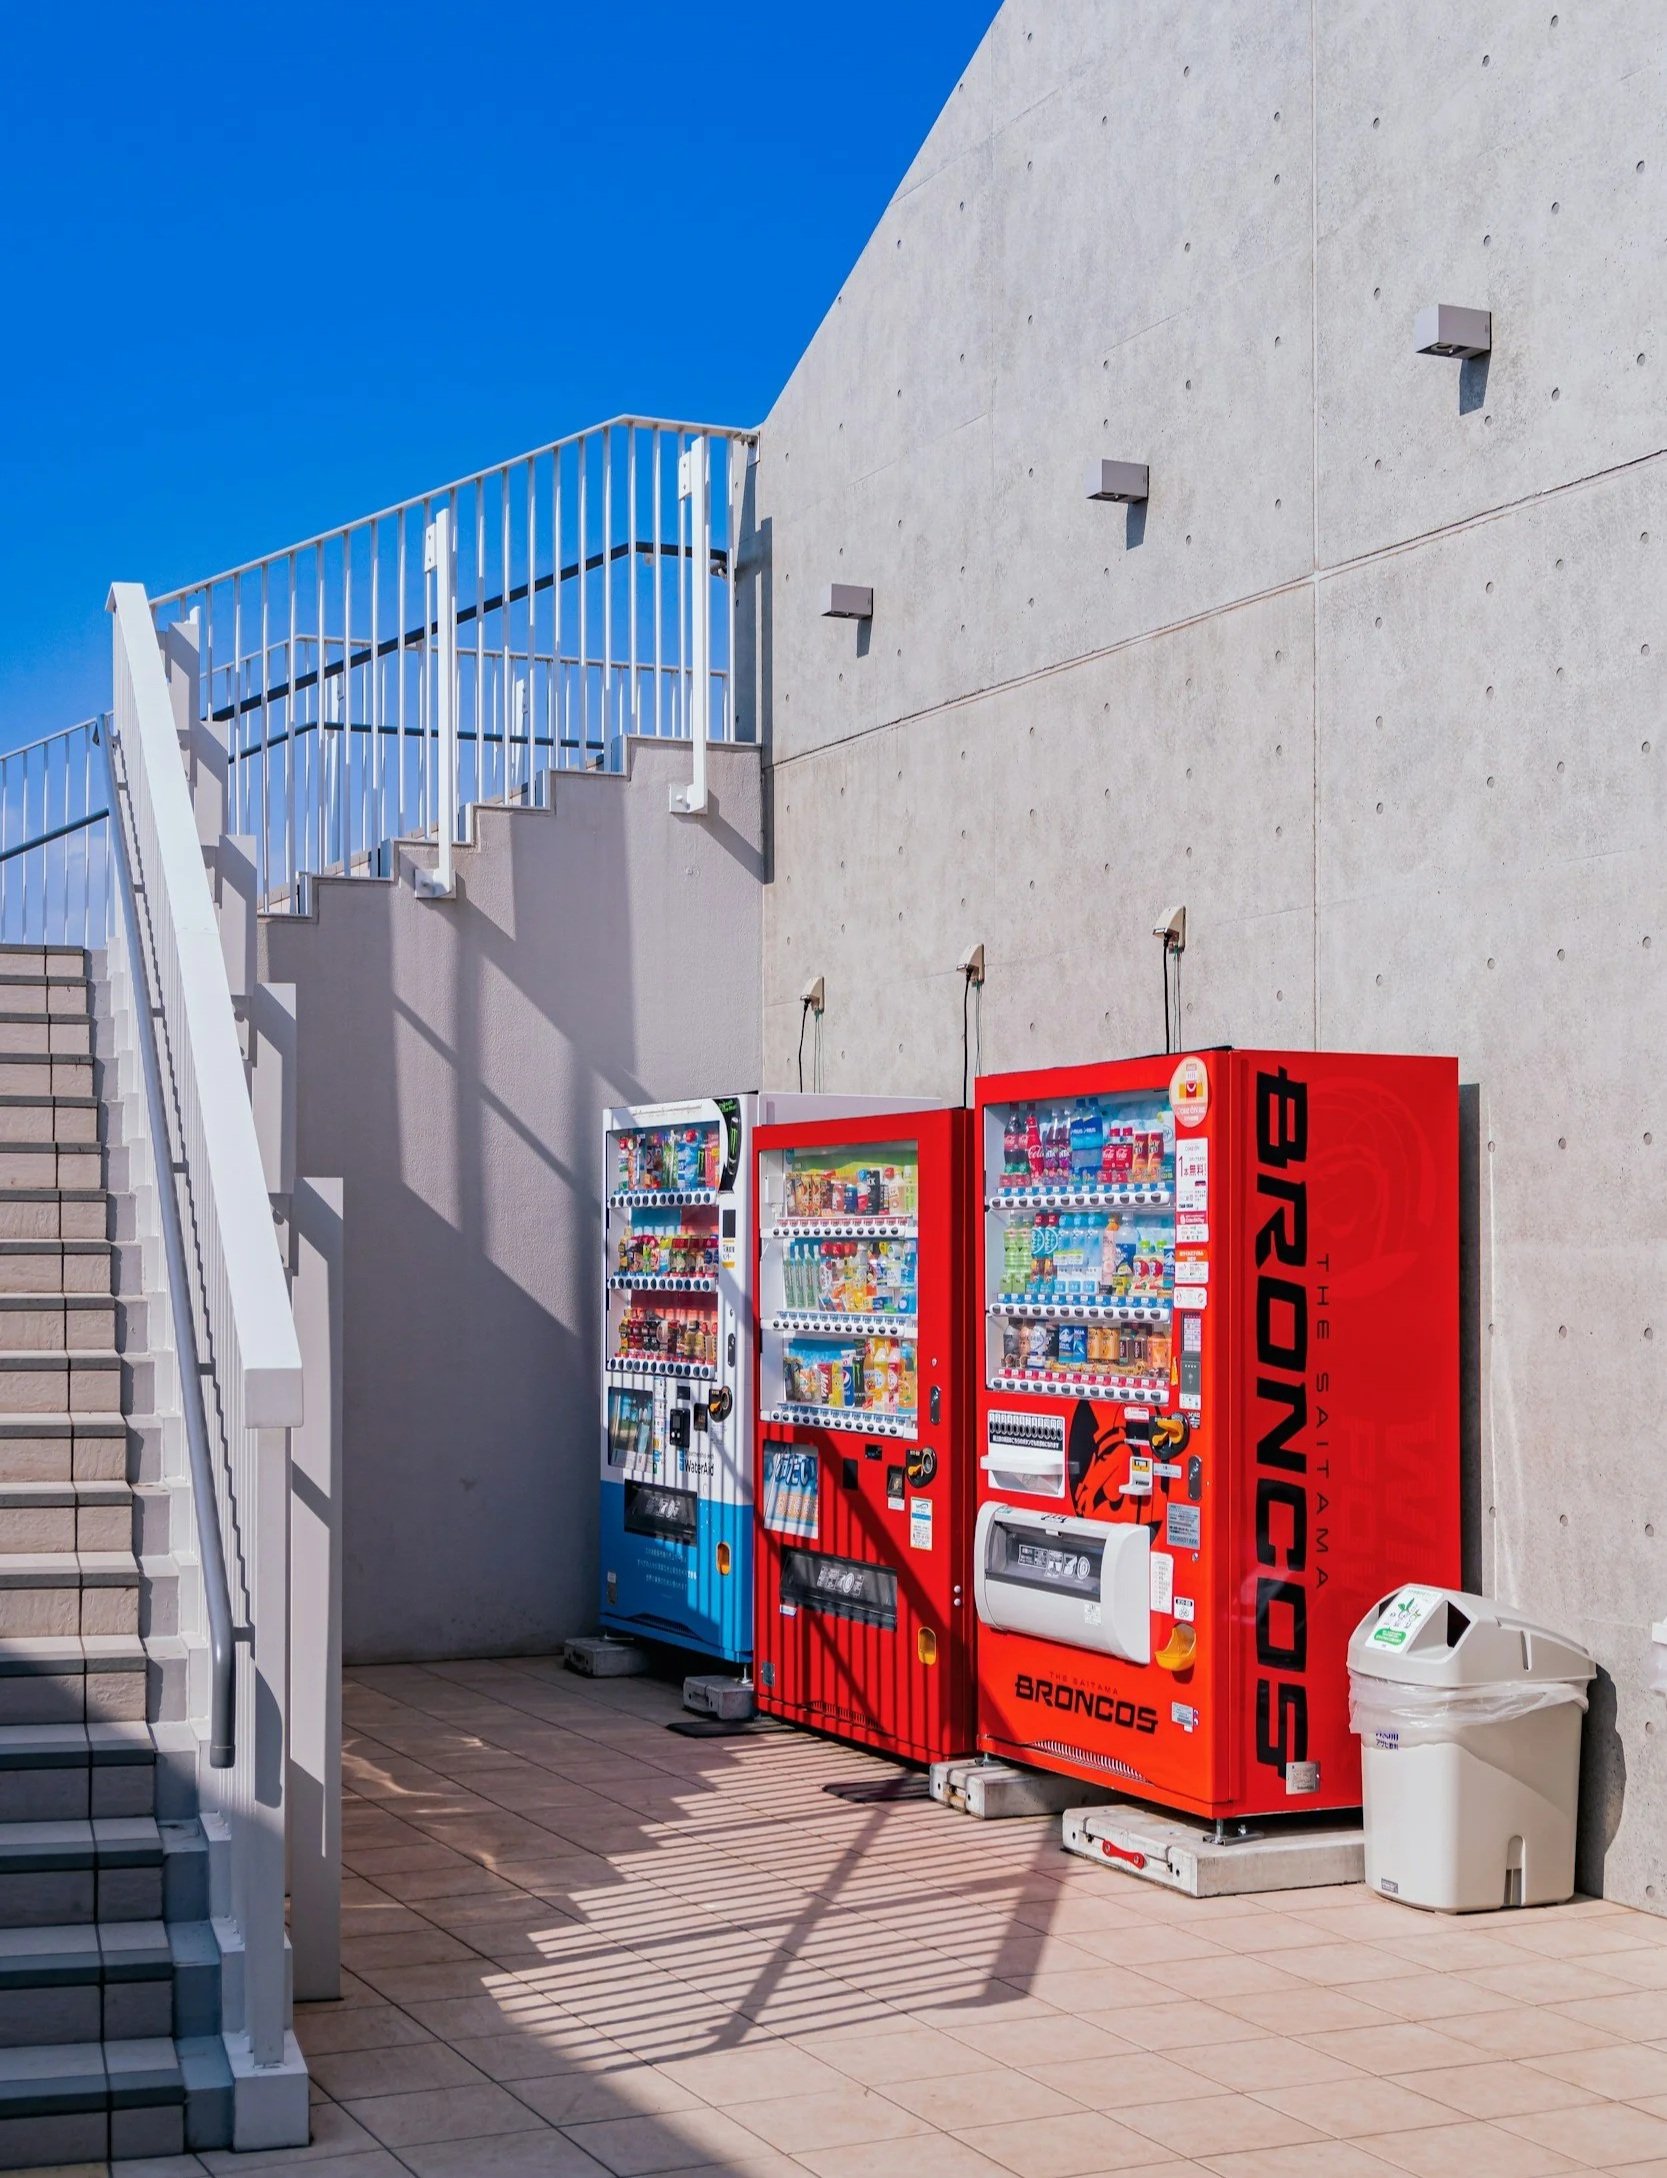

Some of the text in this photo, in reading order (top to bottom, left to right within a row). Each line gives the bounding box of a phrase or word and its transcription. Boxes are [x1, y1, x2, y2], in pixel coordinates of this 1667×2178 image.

[1255, 1065, 1308, 1781] BRONCOS
[1315, 1253, 1330, 1589] THE SAITAMA
[685, 1459, 715, 1476] WaterAid
[1015, 1674, 1158, 1735] BRONCOS
[1050, 1672, 1119, 1695] THE SAITAMA
